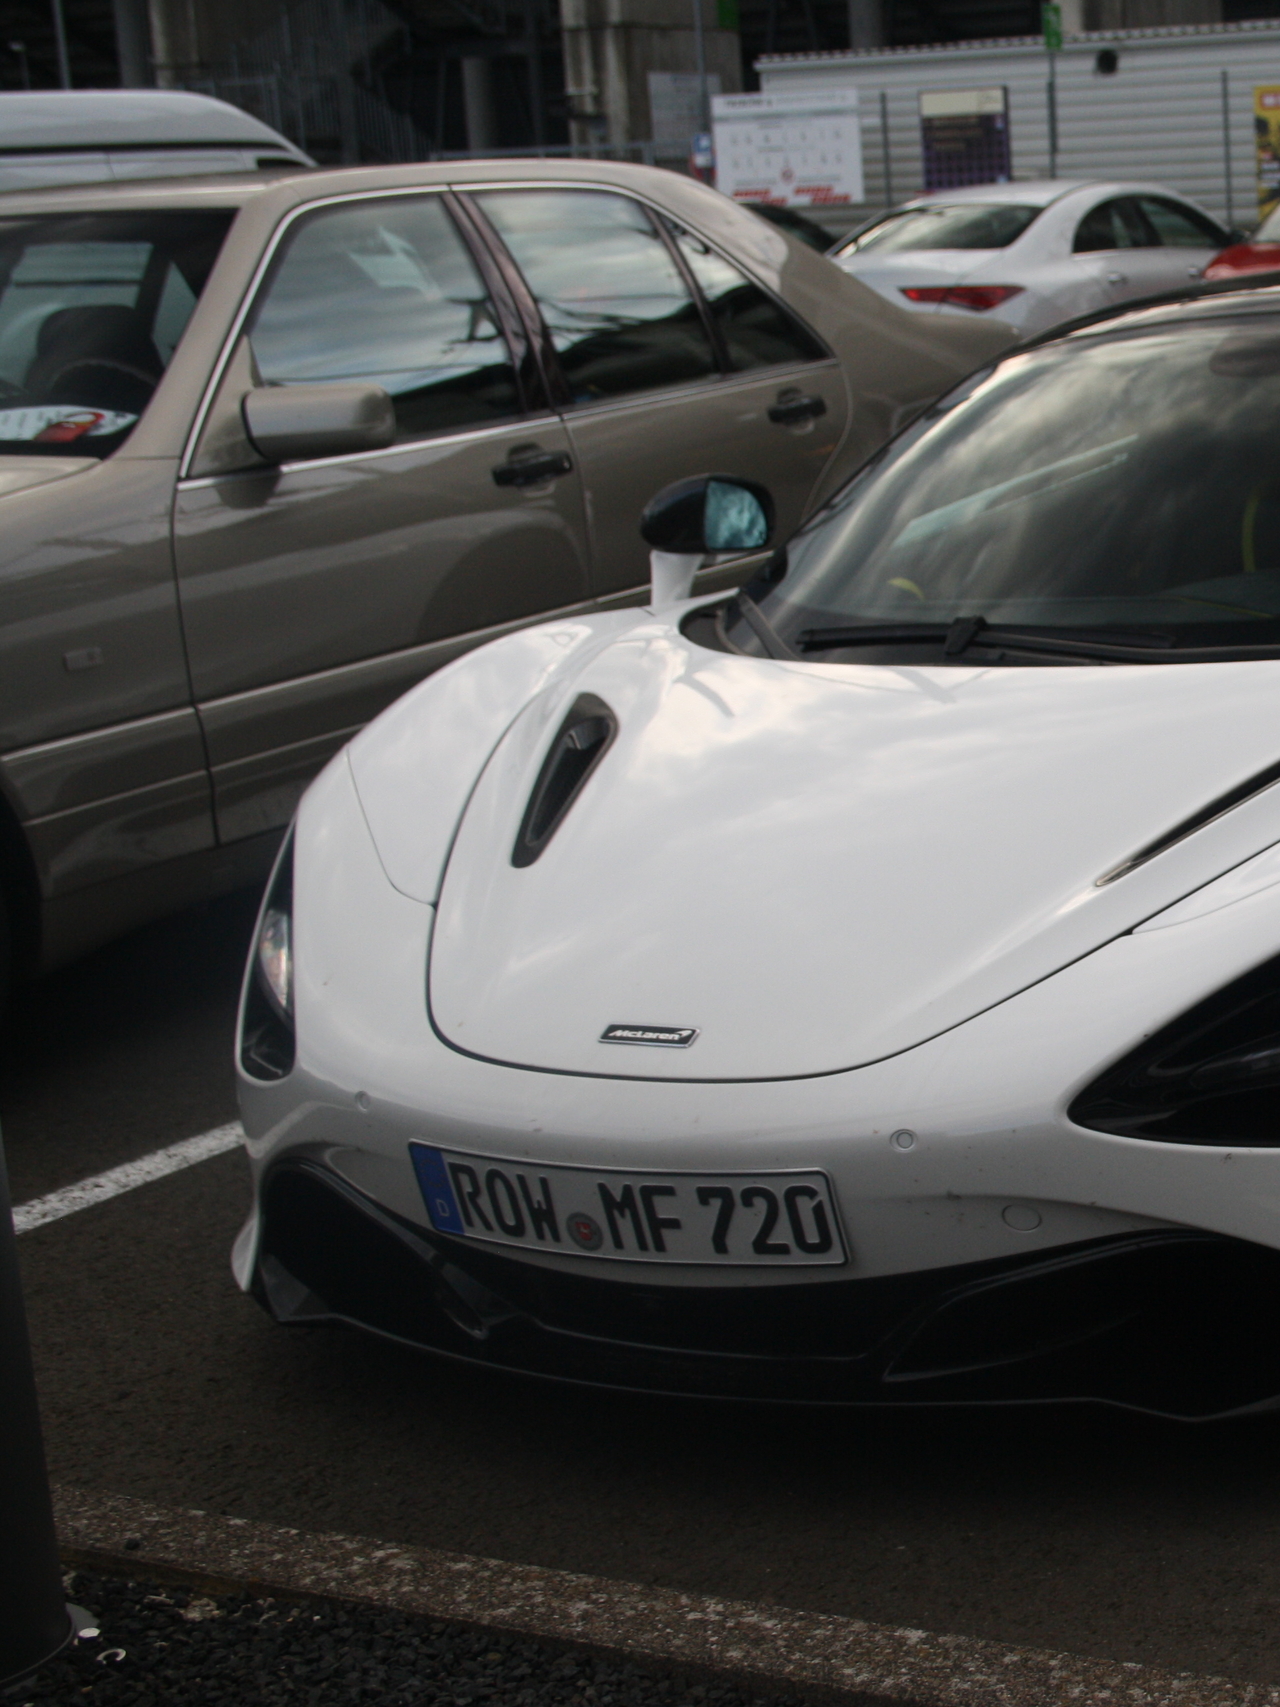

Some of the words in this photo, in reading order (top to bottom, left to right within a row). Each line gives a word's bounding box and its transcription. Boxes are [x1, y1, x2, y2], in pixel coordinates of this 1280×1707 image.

[607, 1028, 681, 1040] McLaren
[435, 1198, 450, 1217] D
[447, 1161, 561, 1243] ROW
[597, 1182, 682, 1252] MF
[696, 1185, 833, 1254] 720
